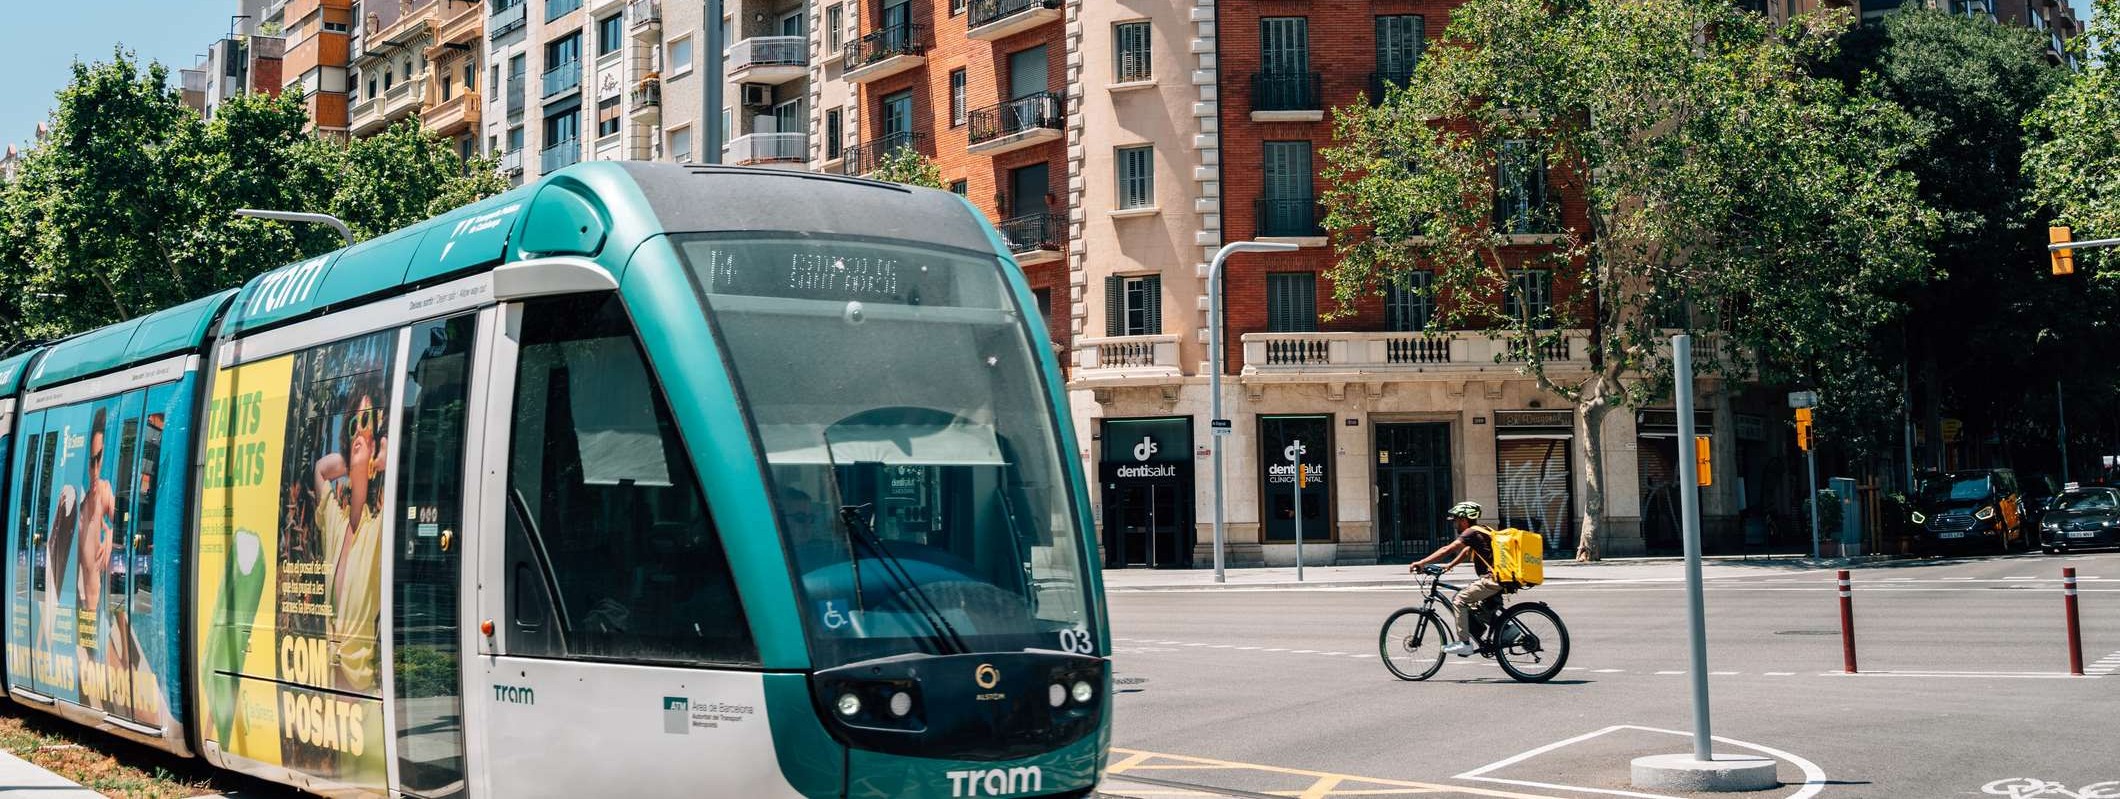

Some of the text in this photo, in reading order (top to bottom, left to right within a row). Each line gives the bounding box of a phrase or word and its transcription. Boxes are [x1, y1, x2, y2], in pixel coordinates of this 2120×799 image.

[209, 390, 263, 440] TANTS
[203, 441, 266, 489] GELATS
[1117, 464, 1176, 478] dentisalut
[1269, 463, 1323, 474] dentalut
[283, 559, 294, 574] Com
[316, 580, 324, 595] les
[1059, 628, 1093, 655] 03
[281, 634, 328, 688] COM
[709, 704, 717, 712] de
[719, 702, 753, 714] Barcelona
[282, 691, 365, 757] POSATS
[946, 765, 1043, 798] Tram
